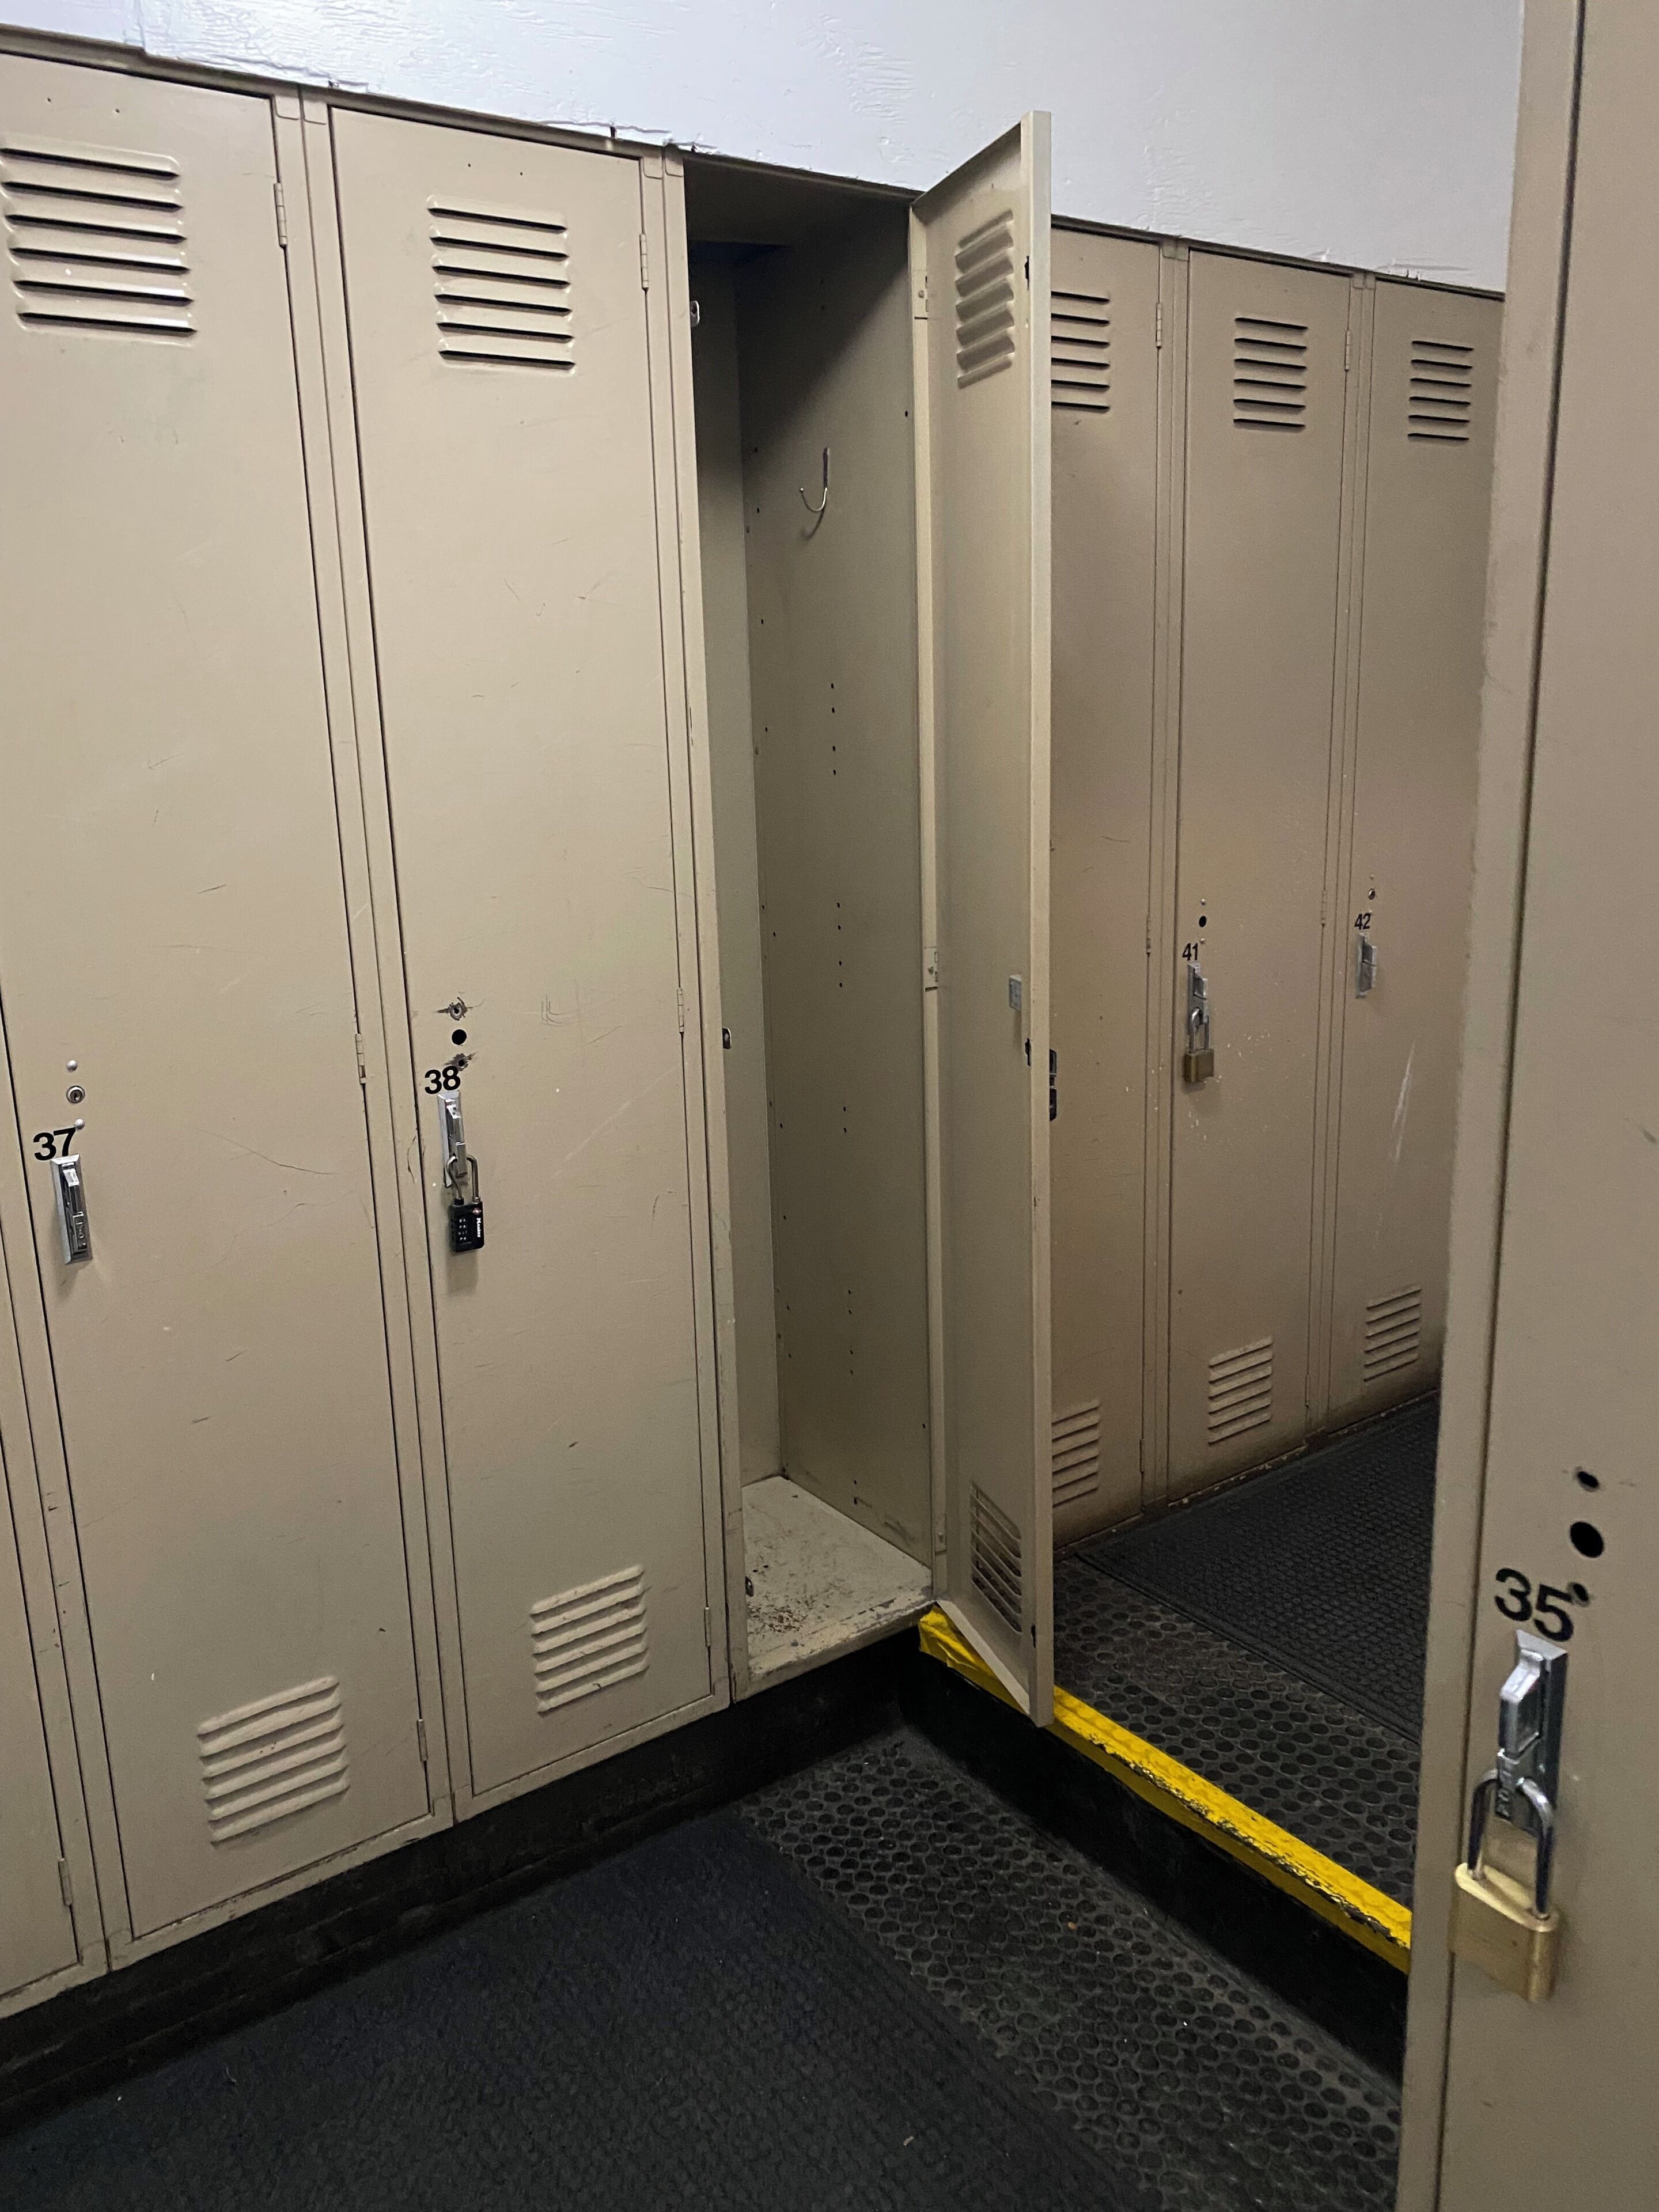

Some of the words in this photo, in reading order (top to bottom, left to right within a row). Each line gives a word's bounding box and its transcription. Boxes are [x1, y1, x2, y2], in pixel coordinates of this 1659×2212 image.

[1354, 913, 1371, 930] 42
[1182, 943, 1198, 960] 41
[425, 1066, 461, 1094] 38
[33, 1127, 76, 1161] 37
[1494, 1567, 1574, 1642] 35
